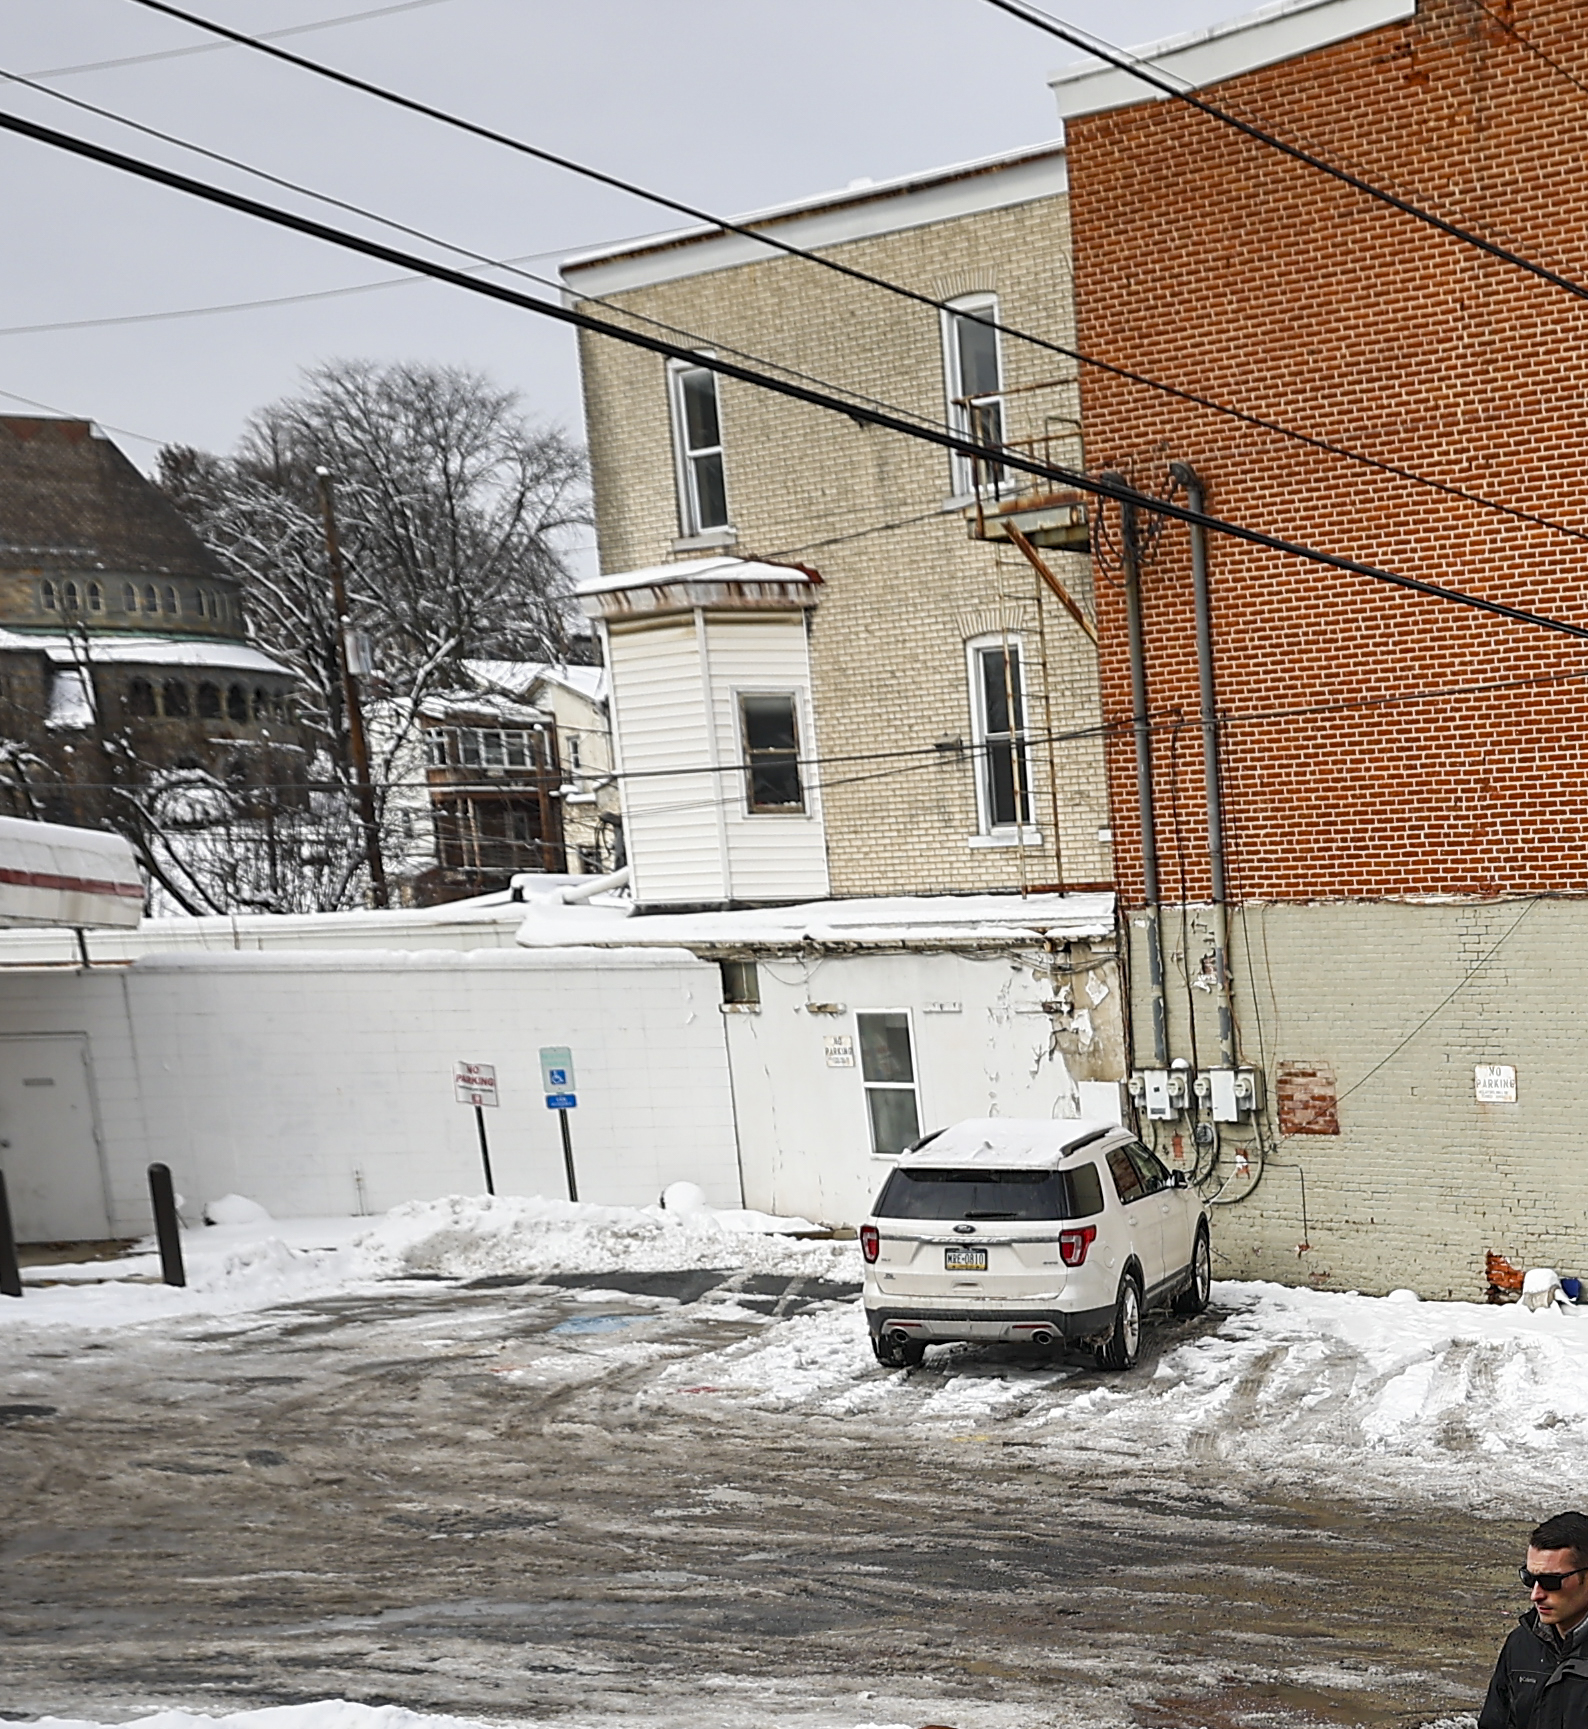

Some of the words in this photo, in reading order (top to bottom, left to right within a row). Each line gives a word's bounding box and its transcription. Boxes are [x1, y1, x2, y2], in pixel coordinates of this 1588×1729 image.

[466, 1065, 479, 1075] NO
[1489, 1066, 1502, 1077] NO
[456, 1074, 495, 1087] PARKING
[1475, 1078, 1515, 1089] PARKING
